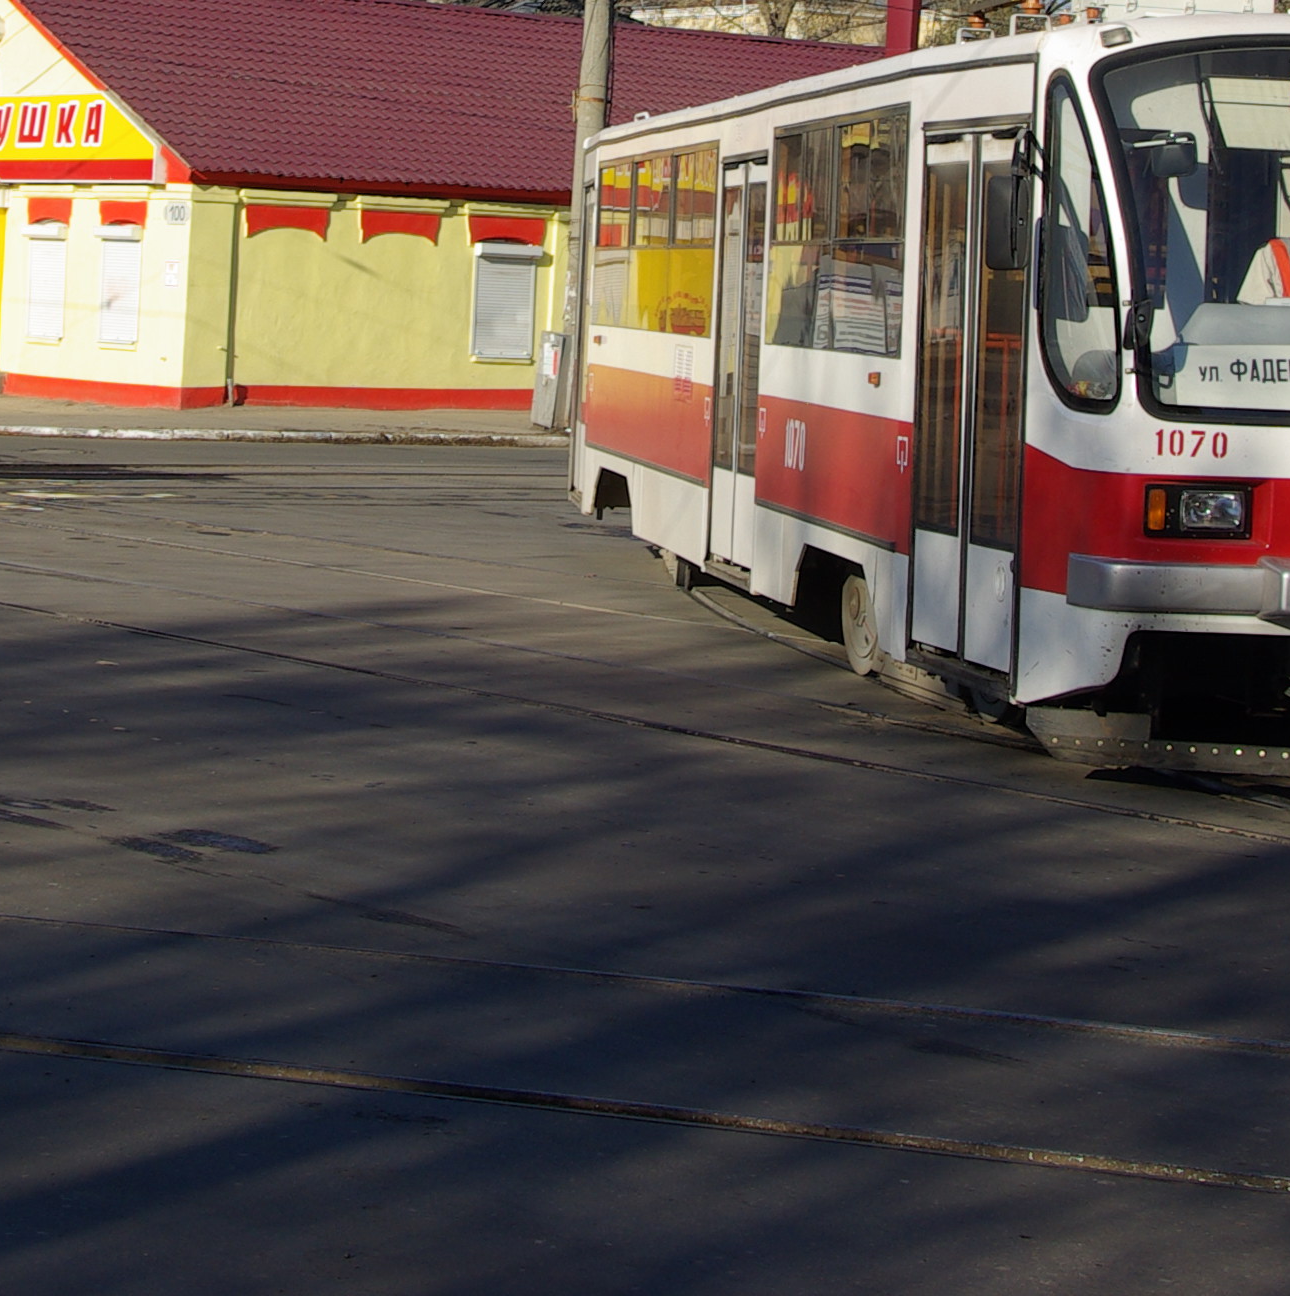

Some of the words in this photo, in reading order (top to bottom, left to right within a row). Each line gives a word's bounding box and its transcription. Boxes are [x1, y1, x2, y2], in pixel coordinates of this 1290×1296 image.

[168, 205, 186, 221] 100
[1198, 365, 1224, 383] ул.
[784, 417, 806, 472] 1070
[1155, 428, 1228, 458] 1070
